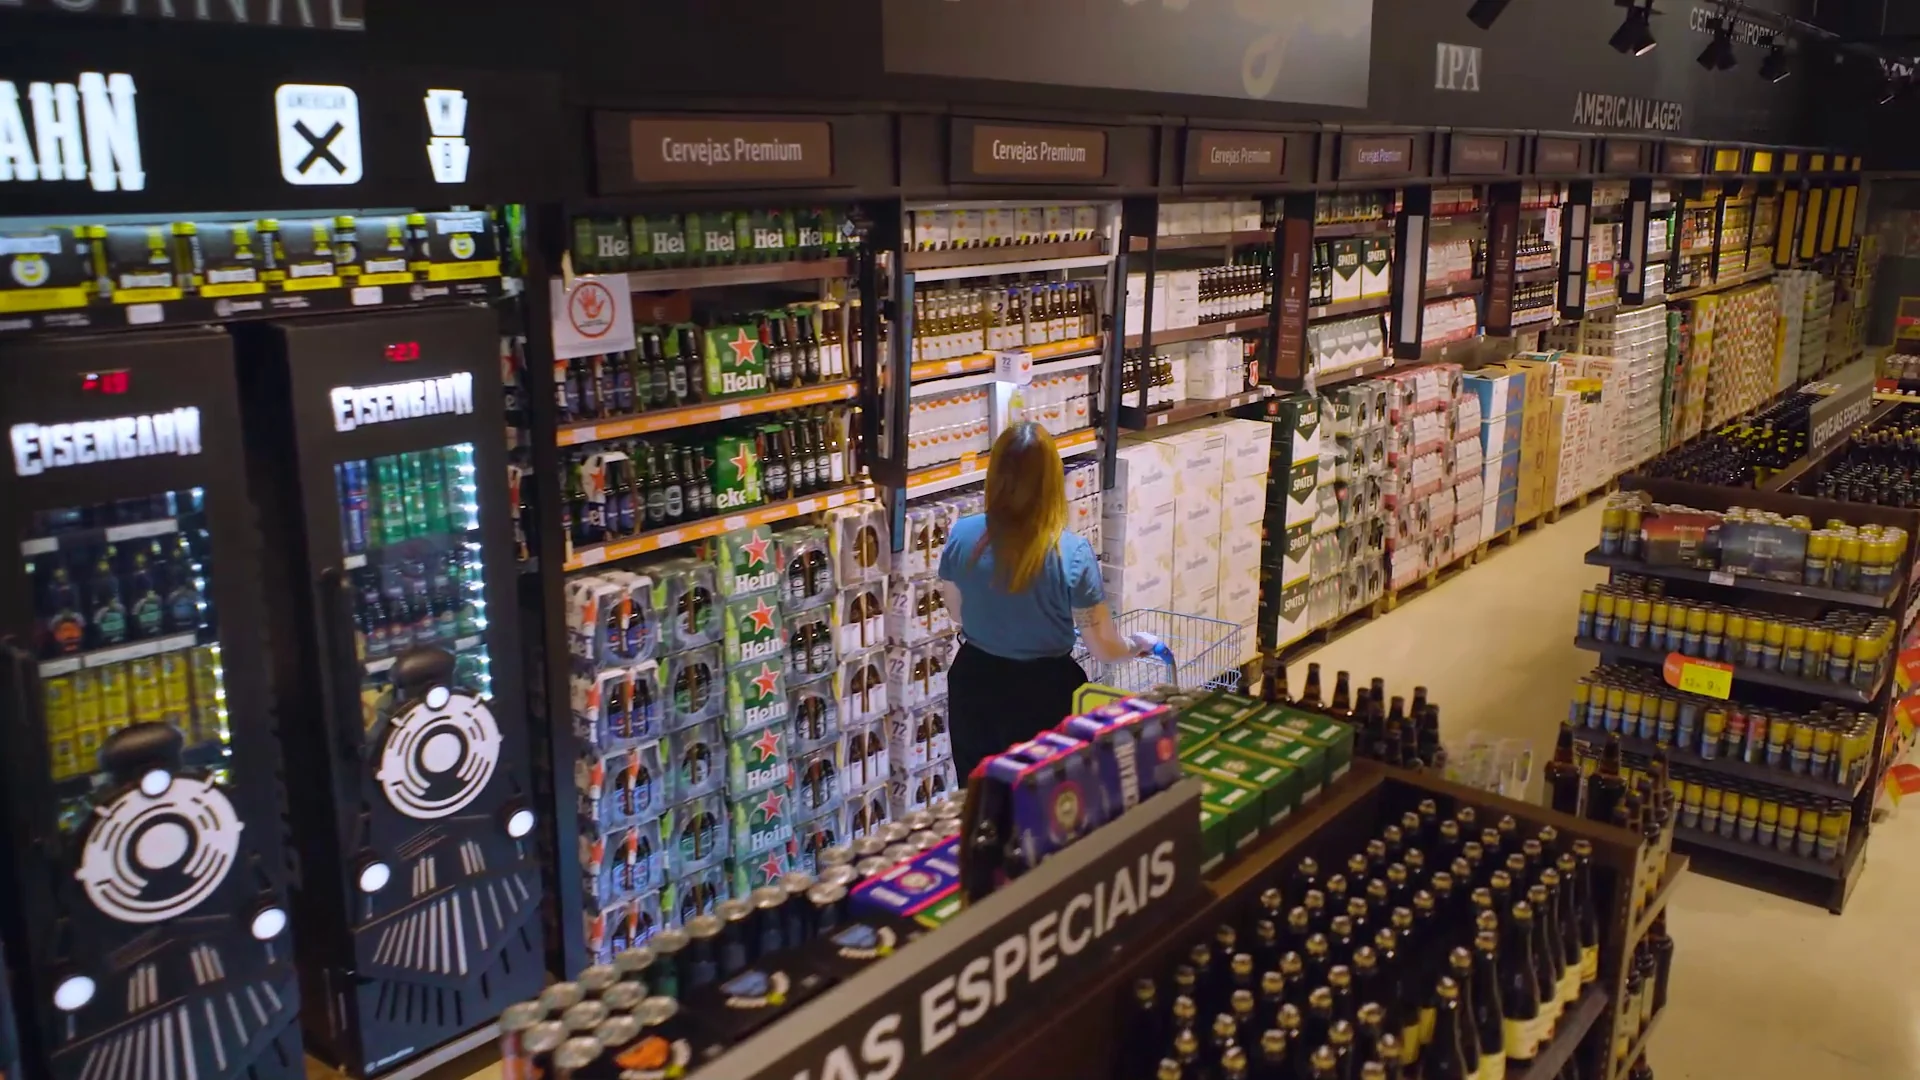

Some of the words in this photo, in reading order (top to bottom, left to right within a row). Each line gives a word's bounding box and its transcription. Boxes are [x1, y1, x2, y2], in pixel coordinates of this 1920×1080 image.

[1434, 42, 1481, 91] IPA
[1572, 91, 1641, 129] AMERICAN
[1643, 99, 1682, 131] LAGER
[661, 137, 731, 165] Cervejas
[734, 138, 803, 161] Premium
[992, 140, 1038, 163] Cervejas
[1040, 141, 1086, 162] Premium
[1210, 146, 1240, 166] Cervejas
[754, 228, 784, 248] Hei
[330, 372, 474, 432] EISENBAHN
[10, 406, 202, 477] EISENBAHN
[1292, 474, 1314, 491] SPATEN
[1290, 533, 1310, 551] SPATEN
[735, 571, 778, 593] Hein
[892, 593, 908, 607] 72
[1284, 593, 1306, 613] SPATEN
[740, 638, 783, 661] Hein
[889, 658, 905, 674] 72
[746, 704, 787, 727] Hein
[892, 720, 907, 735] 72
[747, 765, 789, 789] Hein
[751, 827, 792, 852] Hein
[919, 840, 1177, 1054] ESPECIAIS
